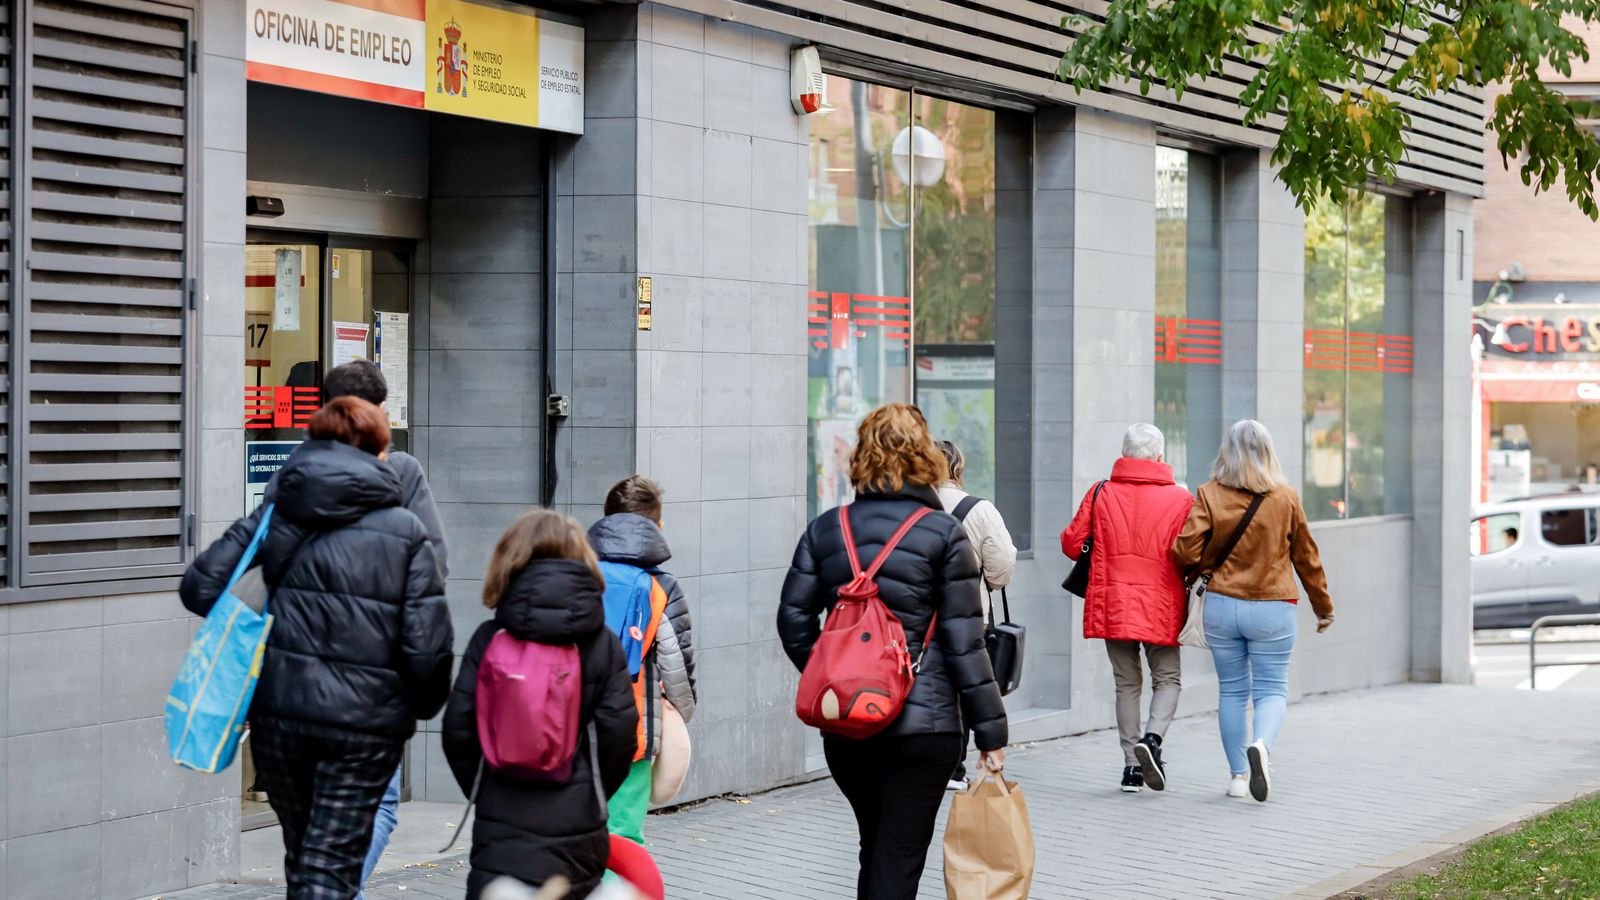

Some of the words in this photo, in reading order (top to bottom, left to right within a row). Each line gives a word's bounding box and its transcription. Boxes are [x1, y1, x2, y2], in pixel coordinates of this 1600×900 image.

[254, 8, 319, 49] OFICINA
[324, 22, 345, 54] DE
[350, 27, 412, 66] EMPLEO
[473, 50, 503, 65] MINISTERIO
[473, 64, 480, 76] DE
[481, 65, 502, 79] EMPLEO
[541, 66, 559, 78] SERVICIO
[472, 79, 477, 90] Y
[477, 80, 507, 95] SEGURIDAD
[508, 85, 527, 98] SOCIAL
[541, 80, 547, 89] DE
[547, 81, 563, 92] EMPLEO
[564, 84, 581, 96] ESTATAL
[248, 323, 269, 349] 17
